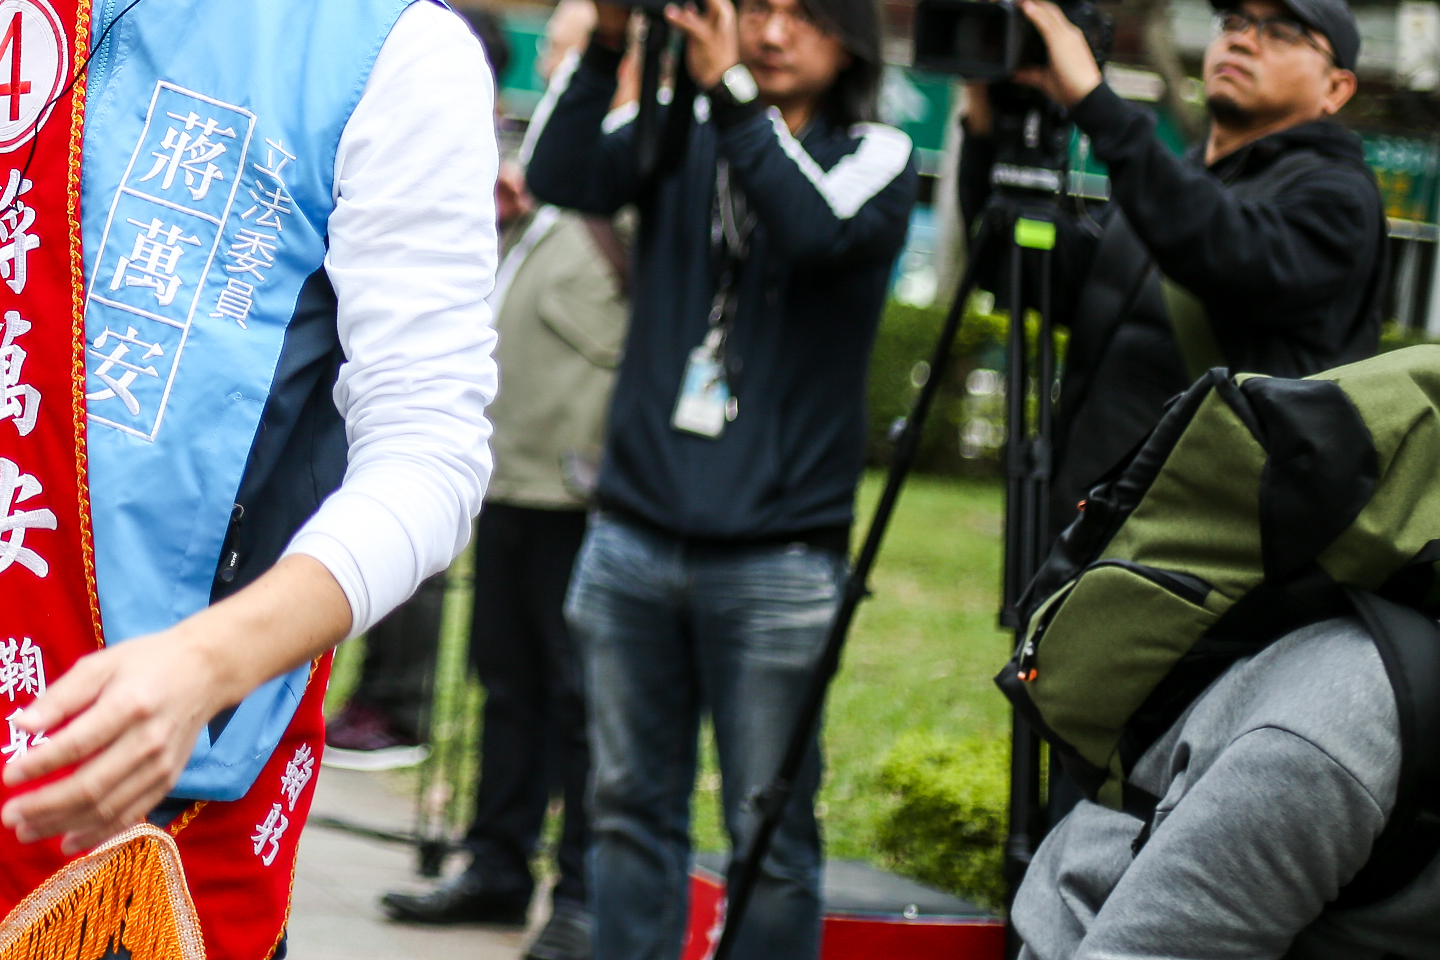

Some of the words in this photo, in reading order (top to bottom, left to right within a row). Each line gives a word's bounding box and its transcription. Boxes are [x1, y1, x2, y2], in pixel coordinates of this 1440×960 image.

[87, 108, 238, 417] 蔣萬安
[208, 137, 298, 330] 立法委員
[249, 742, 315, 867] 鞠躬
